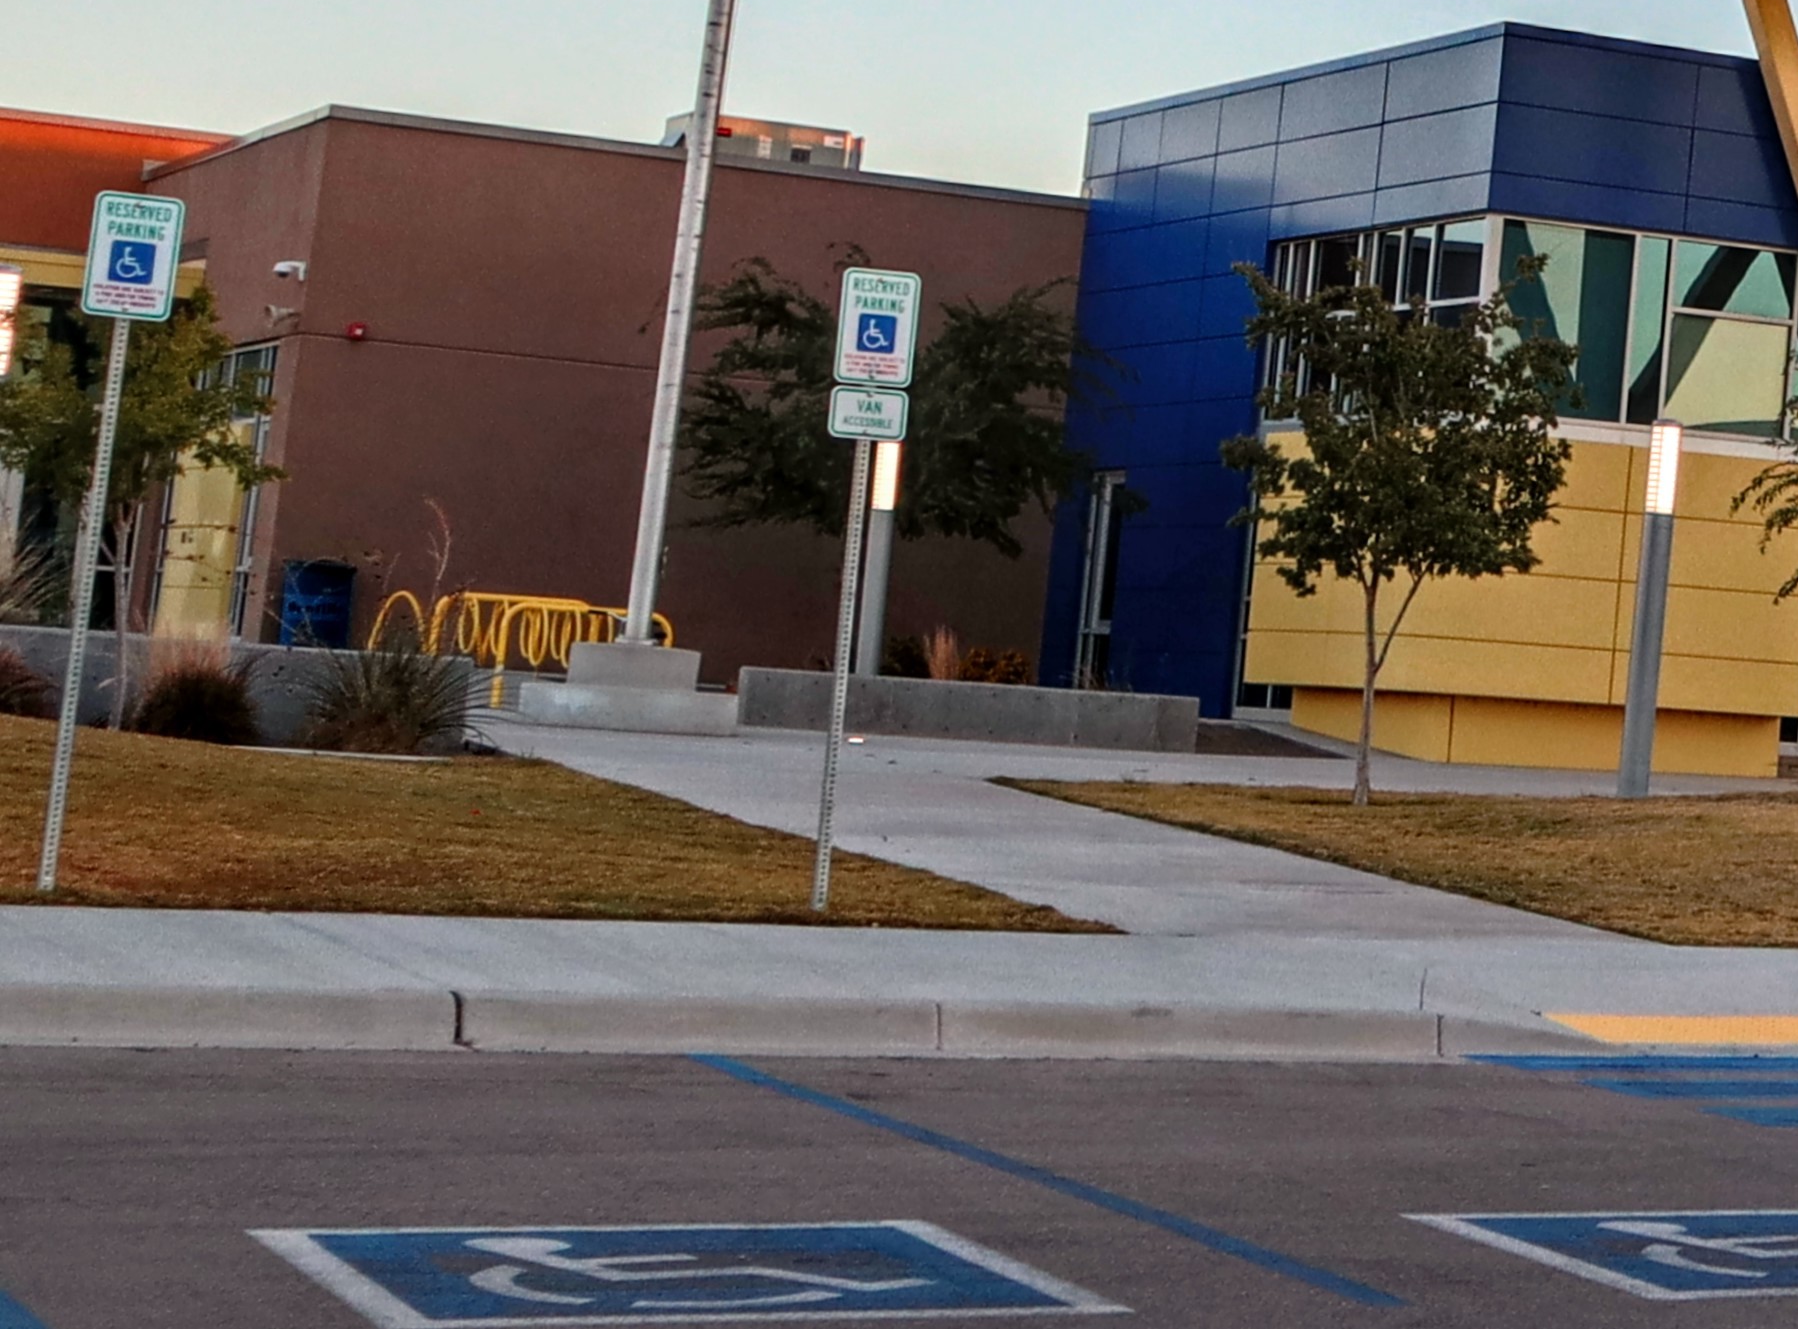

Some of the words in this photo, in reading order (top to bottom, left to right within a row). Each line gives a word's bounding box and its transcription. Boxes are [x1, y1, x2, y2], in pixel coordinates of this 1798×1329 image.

[106, 201, 172, 222] RESERVED
[108, 220, 165, 241] PARKING
[853, 277, 910, 296] RESERVED
[854, 295, 905, 313] PARKING
[857, 399, 883, 414] VAN
[843, 415, 893, 429] ACCESSIBLE
